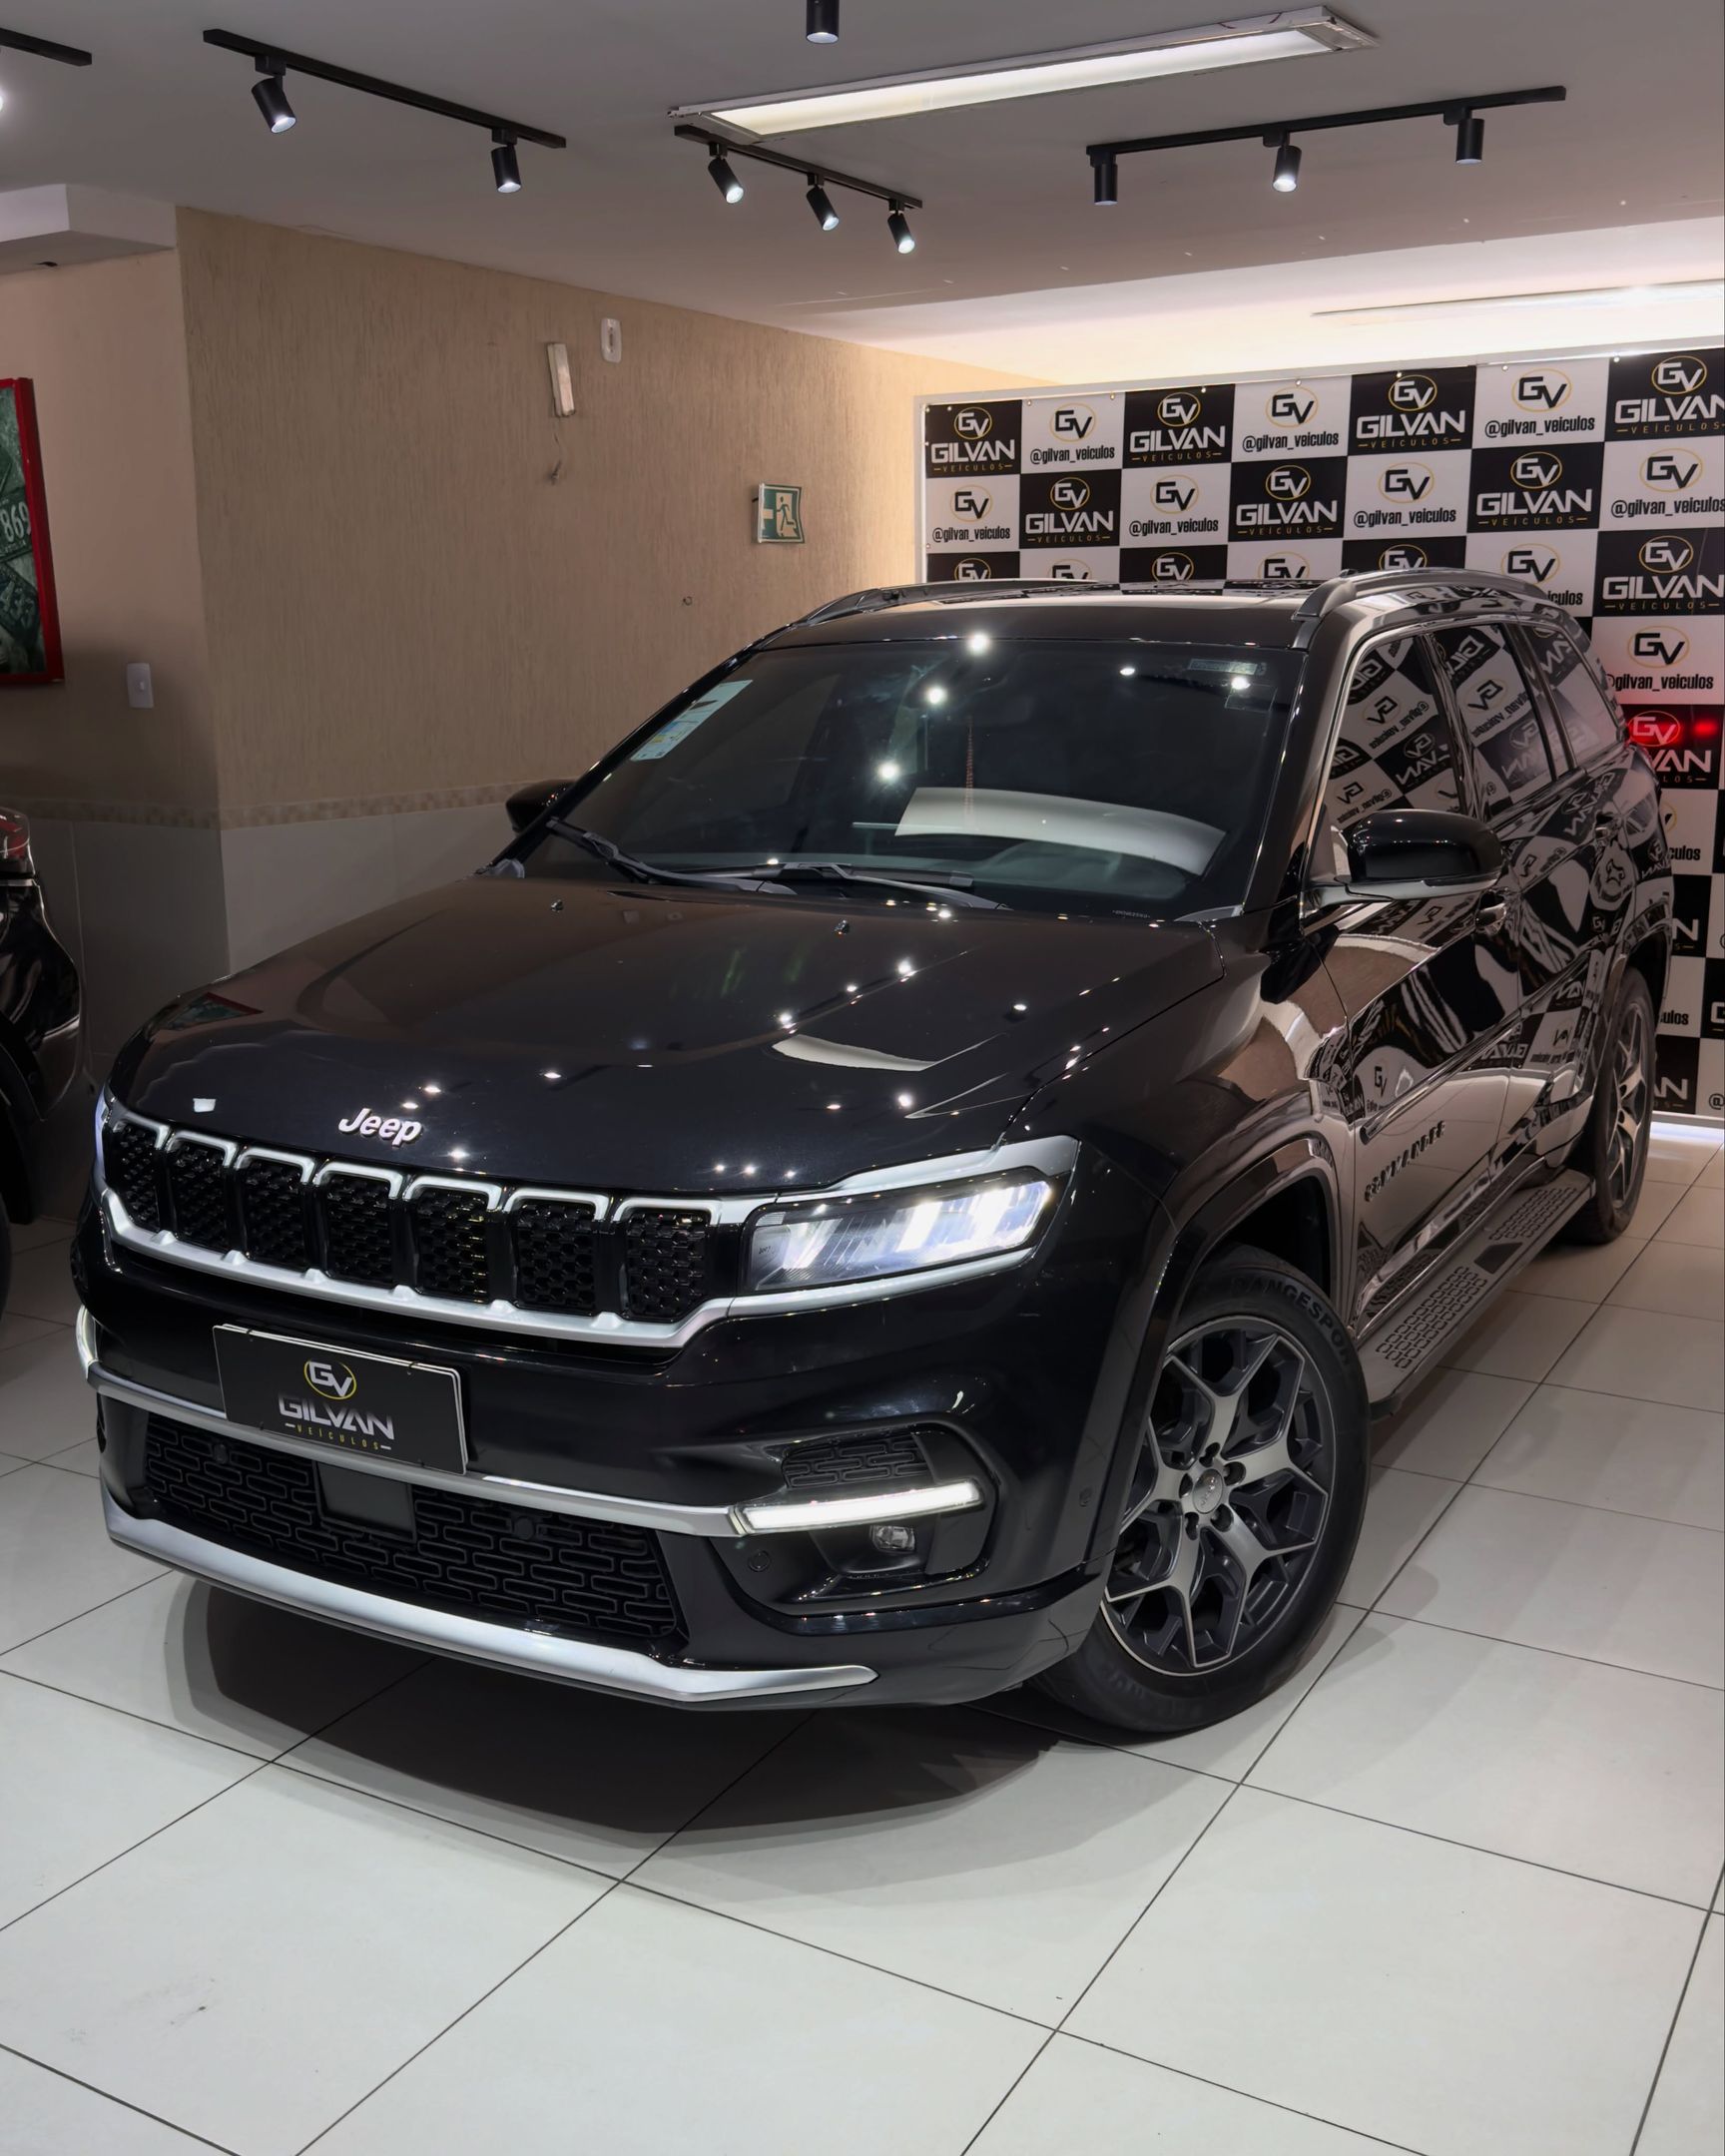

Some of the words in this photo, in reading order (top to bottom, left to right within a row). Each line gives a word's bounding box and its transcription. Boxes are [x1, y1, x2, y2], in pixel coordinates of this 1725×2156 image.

[1657, 362, 1703, 391] GV
[1394, 380, 1434, 409] GV
[1518, 376, 1567, 409] GV
[1162, 397, 1197, 425] GV
[1271, 394, 1313, 425] GV
[1614, 392, 1724, 424] GILVAN
[957, 411, 988, 437] GV
[1055, 409, 1092, 438] GV
[1356, 410, 1465, 439] GILVAN
[1485, 415, 1595, 438] @gilvan_veiculos
[930, 439, 1015, 464] GILVAN
[1130, 426, 1225, 454] GILVAN
[1243, 431, 1339, 453] @gilvan_veiculos
[1030, 445, 1115, 465] @gilvan_veiculos
[1270, 470, 1308, 498] GV
[1385, 469, 1431, 500] GV
[1515, 457, 1558, 486] GV
[1646, 455, 1699, 488] GV
[954, 491, 990, 519] GV
[1053, 482, 1087, 508] GV
[1155, 481, 1196, 511] GV
[1476, 488, 1592, 517] GILVAN
[1611, 497, 1724, 518] @gilvan_veiculos
[1025, 510, 1114, 535] GILVAN
[1129, 517, 1219, 537] @gilvan_veiculos
[1236, 500, 1338, 527] GILVAN
[1354, 507, 1456, 527] @gilvan_veiculos
[932, 526, 1010, 543] @gilvan_veiculos
[1157, 558, 1190, 580] GV
[1506, 551, 1556, 582] GV
[1644, 542, 1690, 572] GV
[1602, 575, 1724, 600] GILVAN
[1634, 633, 1685, 665] GV
[1632, 716, 1676, 745] GV
[338, 1107, 421, 1147] Jeep
[308, 1360, 353, 1397] GV
[278, 1393, 395, 1439] GILVAN
